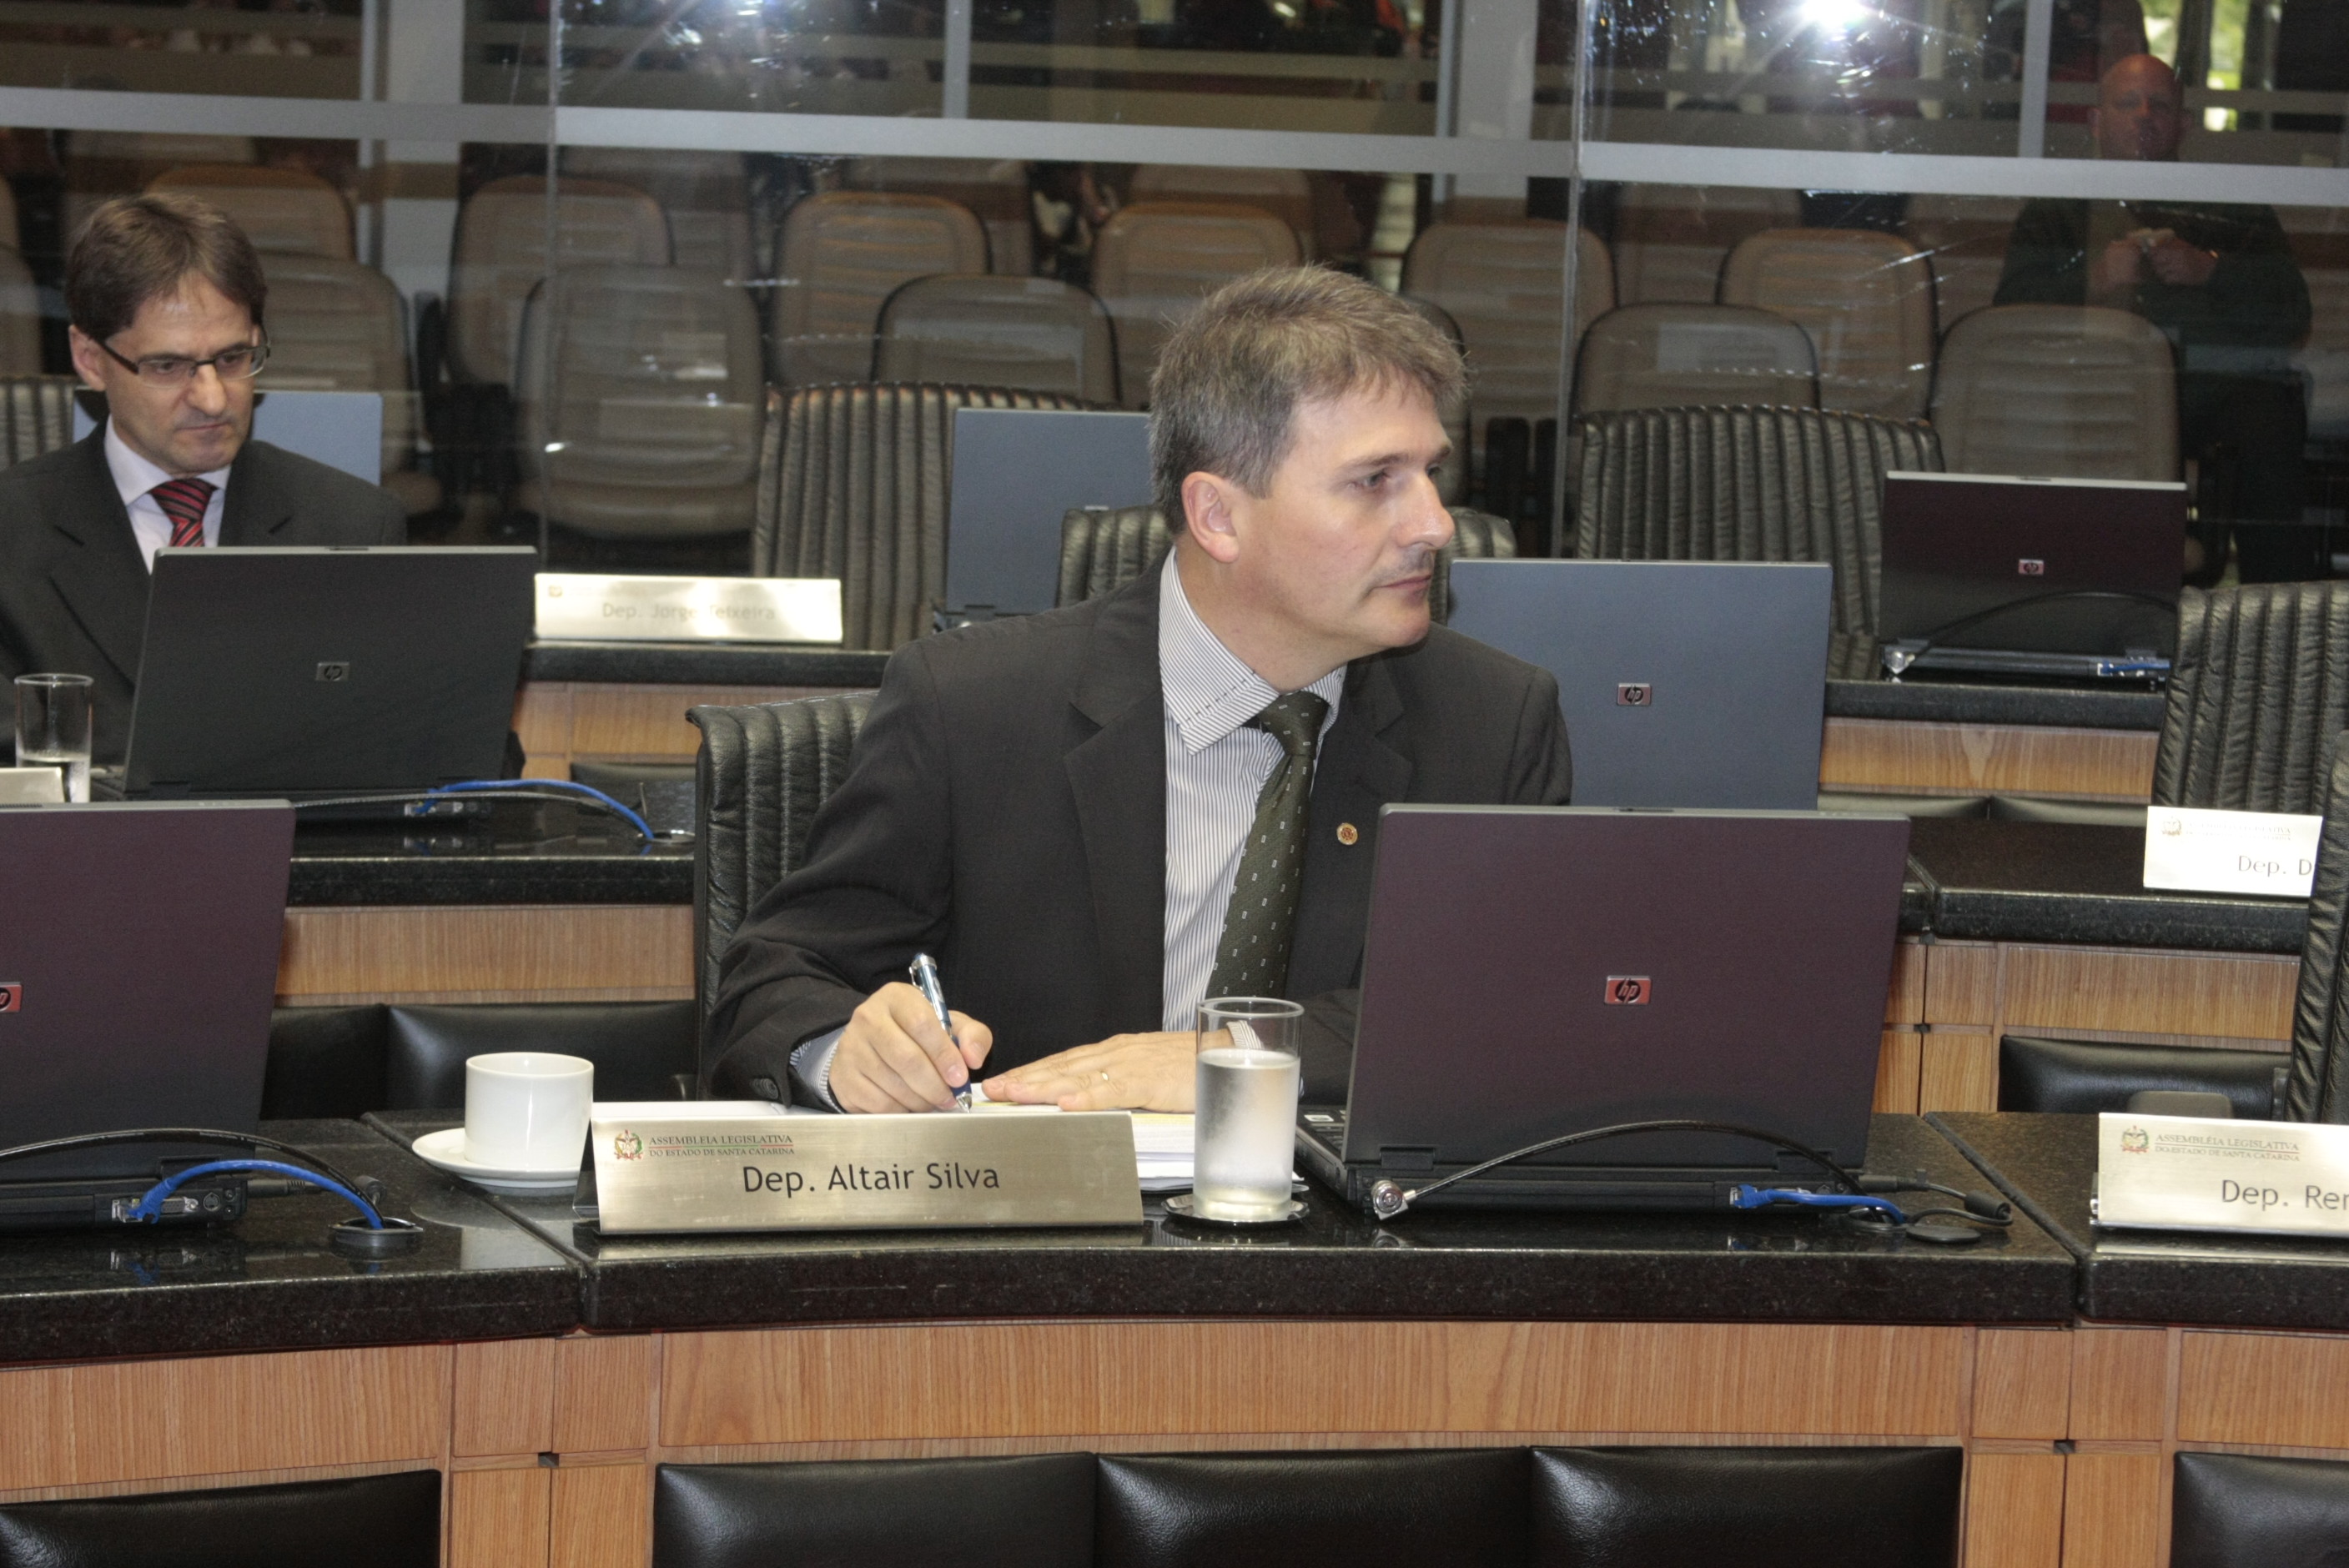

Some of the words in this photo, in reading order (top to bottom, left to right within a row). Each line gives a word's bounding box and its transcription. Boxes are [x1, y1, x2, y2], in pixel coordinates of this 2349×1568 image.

[601, 603, 642, 621] Dep.
[651, 603, 697, 621] Jorge
[2238, 855, 2286, 877] Dep.
[721, 1134, 793, 1144] LEGISLATIVA
[2226, 1138, 2300, 1151] LEGISLATIVA
[650, 1149, 664, 1158] DO
[666, 1148, 702, 1157] ESTADO
[717, 1148, 747, 1156] SANTA
[748, 1148, 795, 1156] CATARINA
[2170, 1147, 2206, 1155] ESTADO
[2221, 1150, 2252, 1158] SANTA
[2253, 1152, 2300, 1162] CATARINA
[742, 1166, 816, 1198] Dep.
[827, 1162, 915, 1192] Altair
[927, 1162, 1001, 1190] Silva
[2221, 1179, 2289, 1211] Dep.
